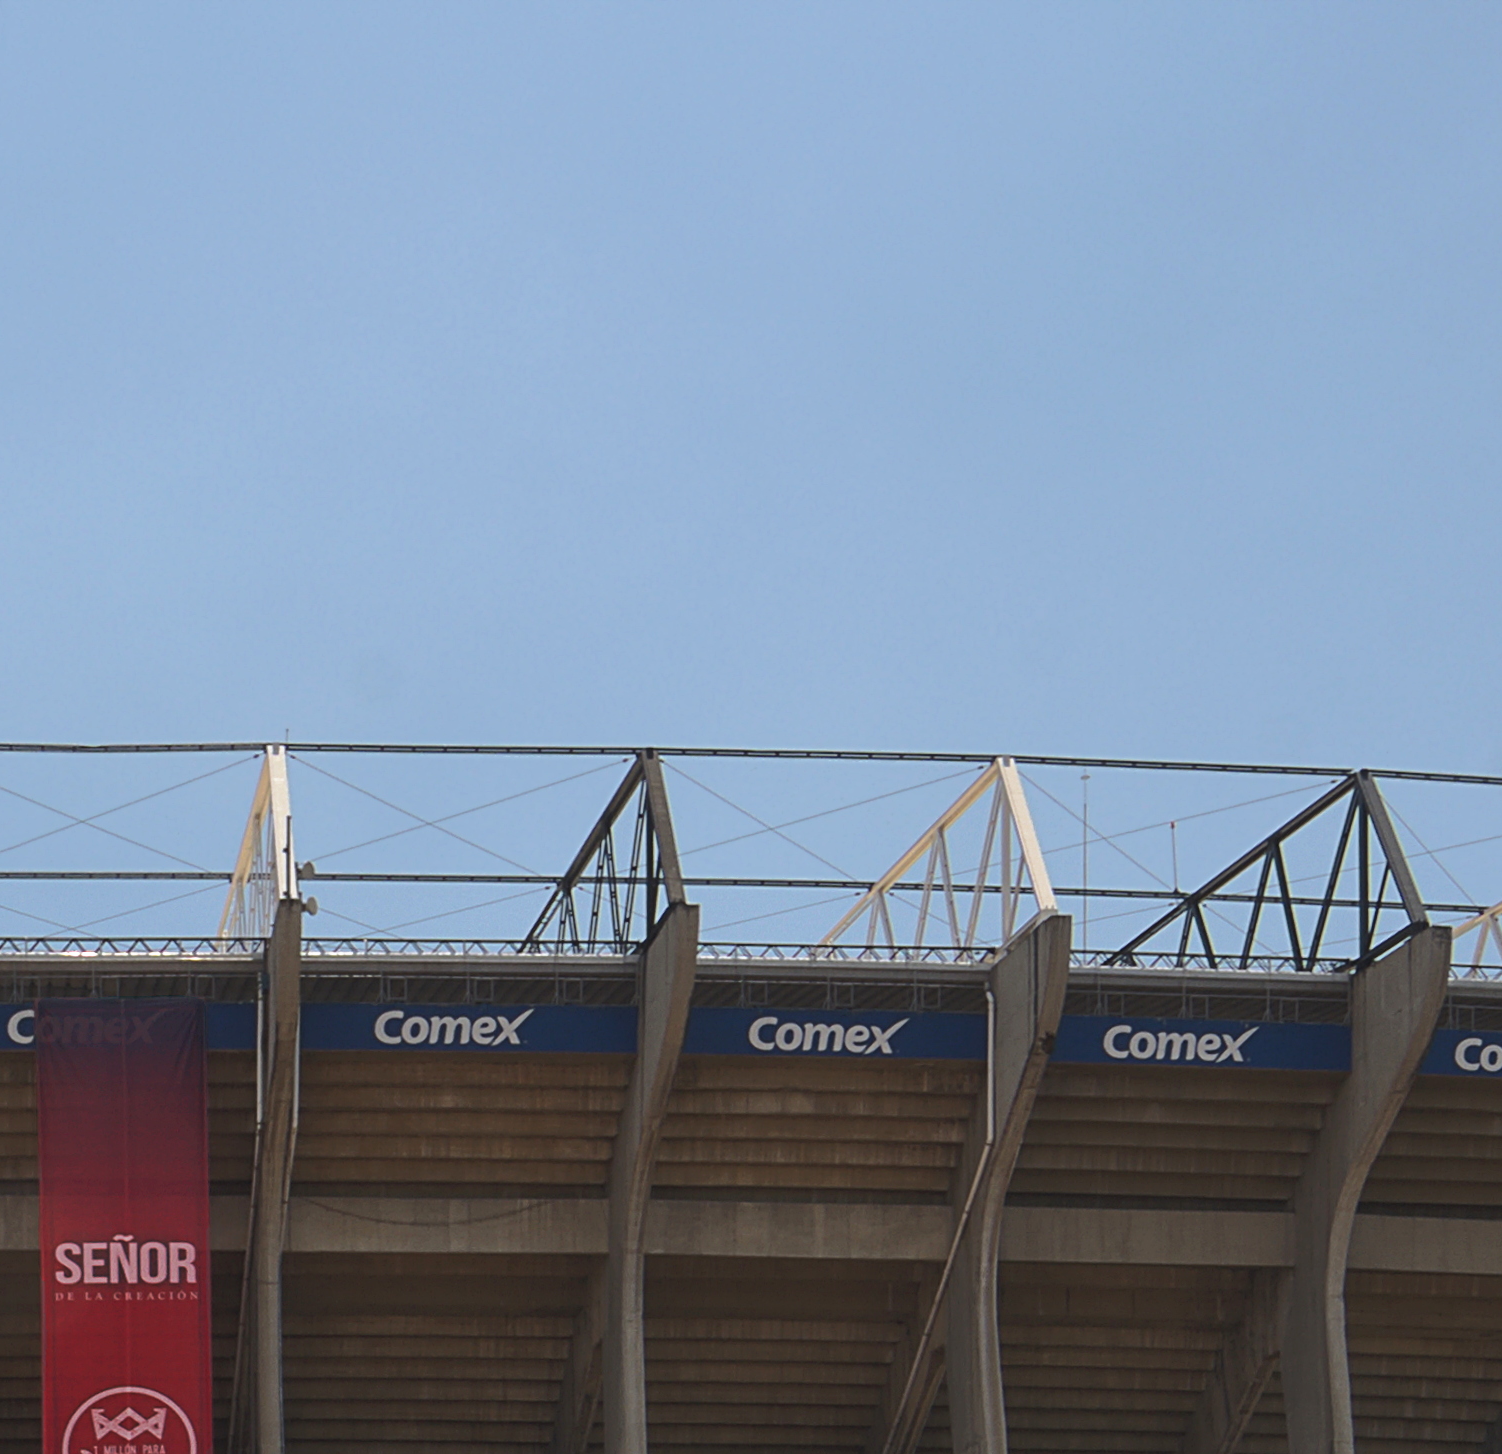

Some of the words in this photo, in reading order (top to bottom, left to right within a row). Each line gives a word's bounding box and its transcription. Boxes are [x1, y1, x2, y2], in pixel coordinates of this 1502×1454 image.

[374, 1009, 534, 1046] Comex
[748, 1016, 908, 1054] Comex
[1103, 1025, 1258, 1063] Comex
[54, 1234, 197, 1285] SEÑOR
[55, 1292, 74, 1301] DE
[85, 1292, 103, 1300] LA
[113, 1290, 199, 1301] CREACIÓN
[142, 1445, 166, 1454] PARA
